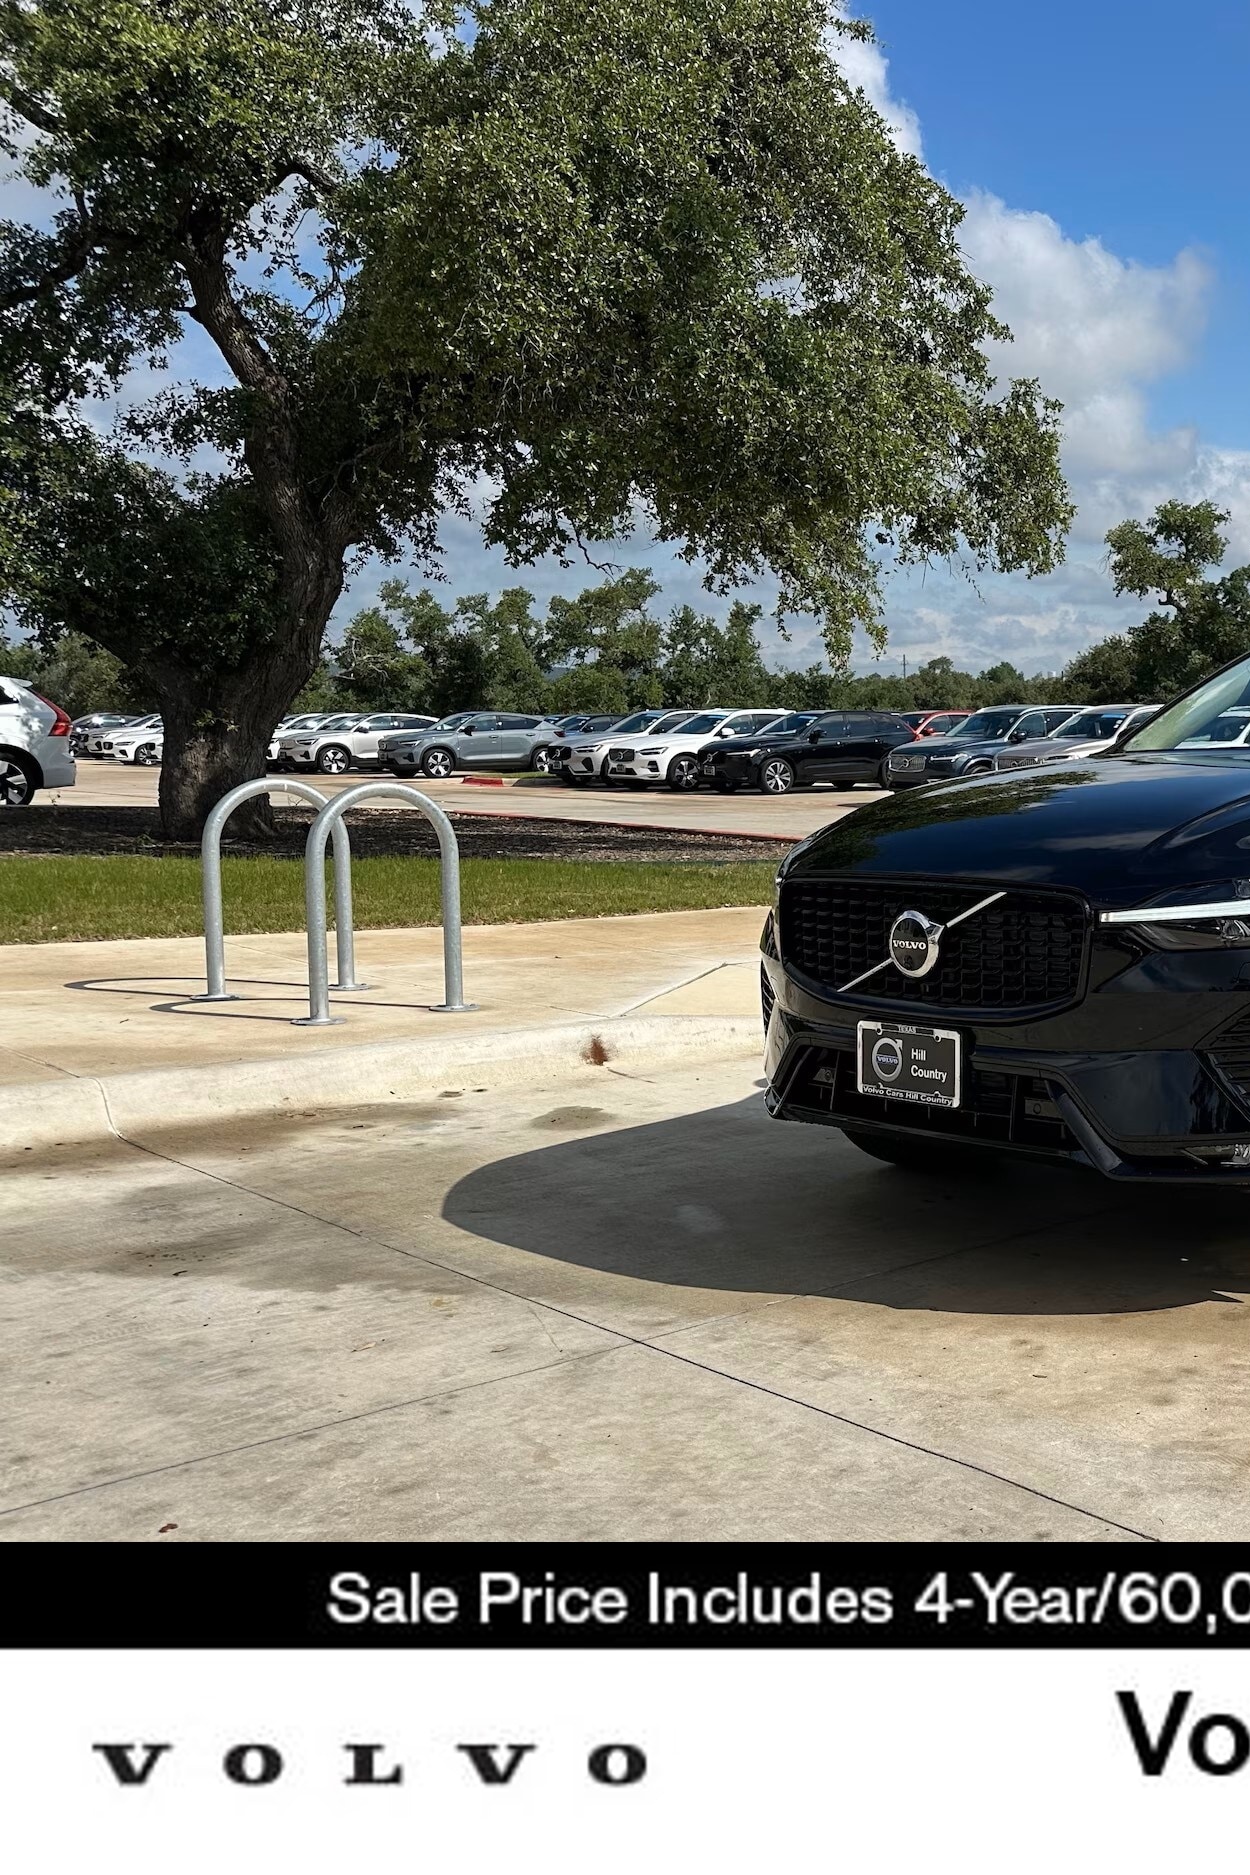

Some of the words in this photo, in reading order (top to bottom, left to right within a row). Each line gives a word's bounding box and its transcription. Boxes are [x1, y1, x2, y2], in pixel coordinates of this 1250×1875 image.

[892, 939, 927, 950] VOLVO
[876, 1055, 899, 1065] VOLVO
[911, 1048, 926, 1061] Hill
[910, 1065, 947, 1083] Country
[863, 1085, 885, 1095] Volvo
[885, 1089, 904, 1099] Cars
[905, 1091, 919, 1101] Hill
[920, 1094, 953, 1107] Country
